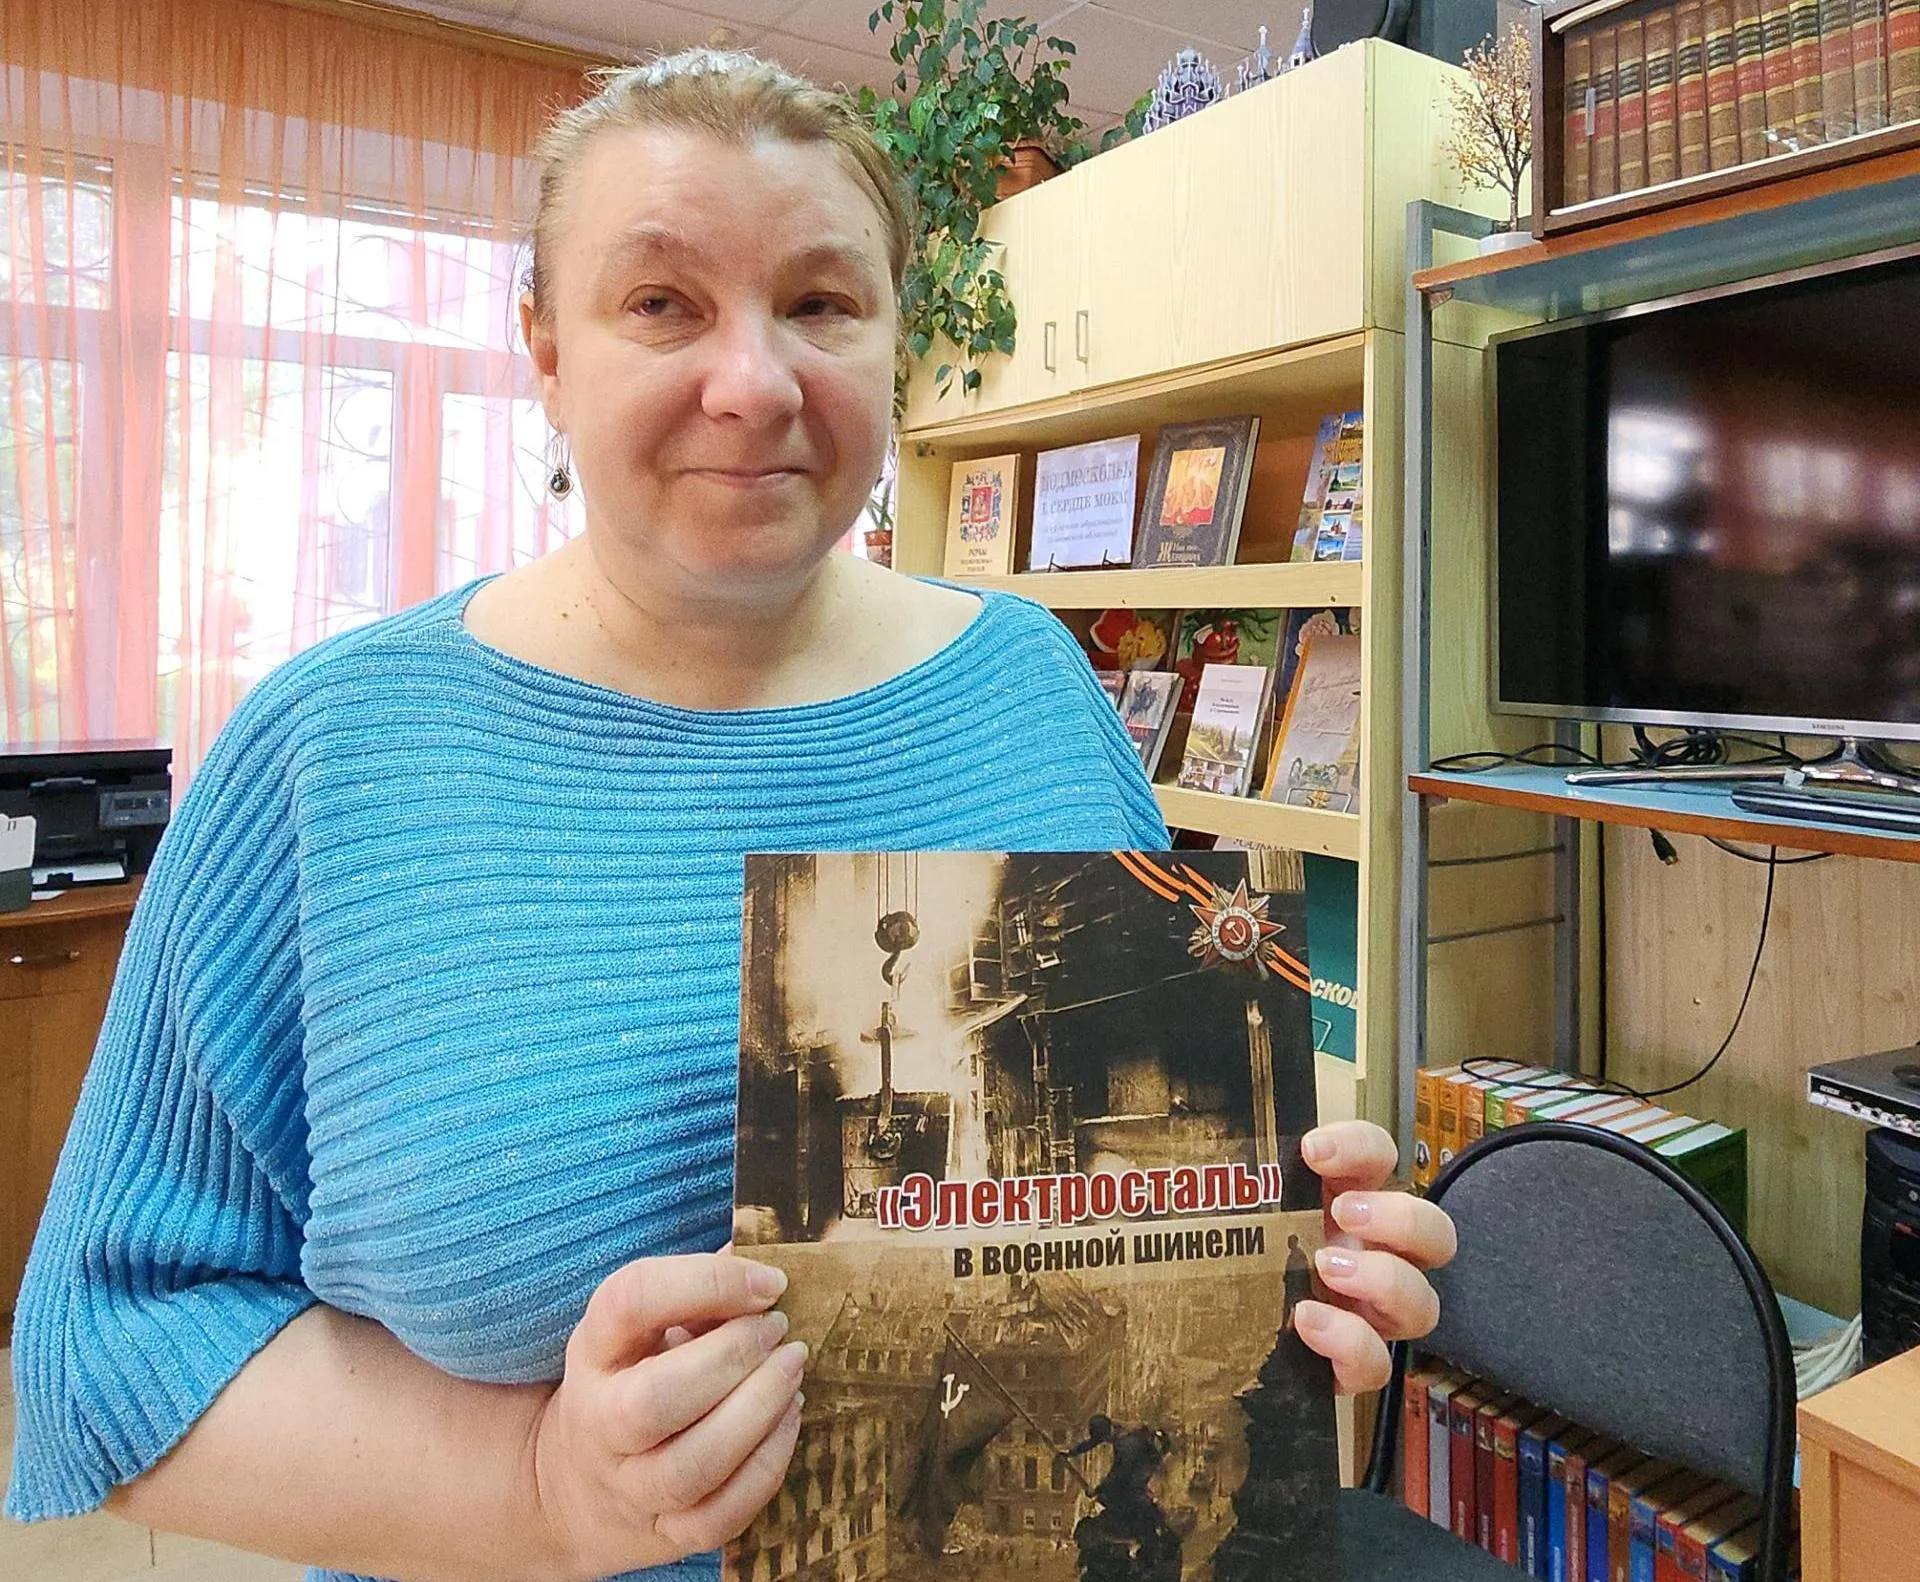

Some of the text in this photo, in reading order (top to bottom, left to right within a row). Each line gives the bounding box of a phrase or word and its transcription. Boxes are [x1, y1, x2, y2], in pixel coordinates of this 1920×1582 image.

[878, 1163, 1282, 1231] «Электросталь»
[953, 1226, 1265, 1278] в военной шинели
